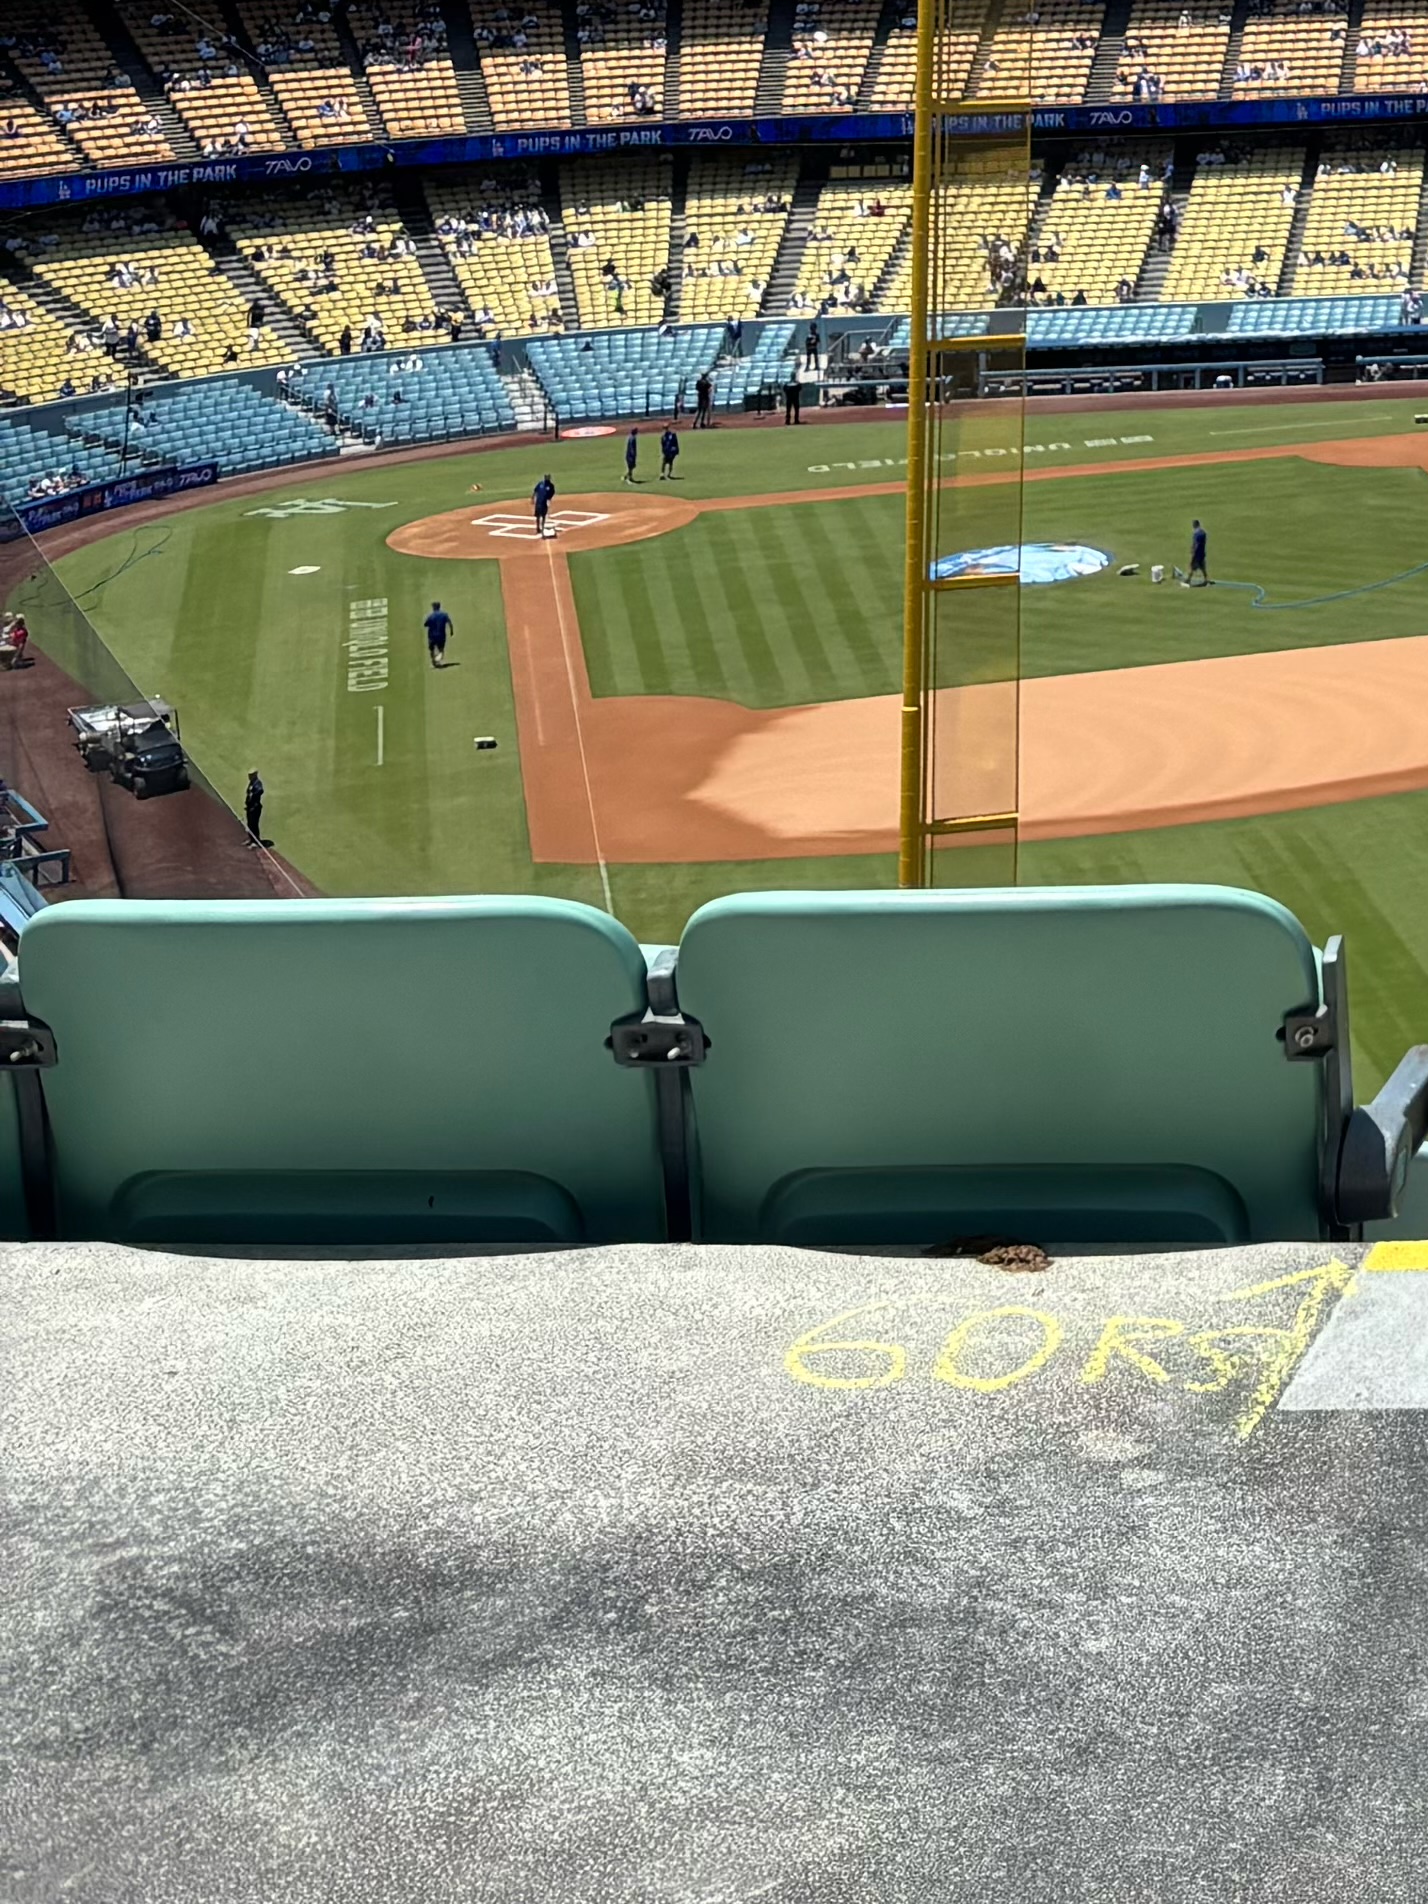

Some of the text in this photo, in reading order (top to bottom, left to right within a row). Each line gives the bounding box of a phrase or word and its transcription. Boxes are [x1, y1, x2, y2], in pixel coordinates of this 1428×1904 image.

[1321, 102, 1361, 116] PUPS
[1364, 101, 1379, 114] IN
[1384, 100, 1414, 114] THE
[993, 114, 1022, 129] THE
[1026, 112, 1065, 127] PARK
[1089, 110, 1132, 125] TAVO
[517, 130, 662, 153] PUPS IN THE PARK
[688, 126, 733, 141] TAVO
[265, 157, 312, 175] TAVO
[85, 164, 237, 194] PUPS IN THE PARK
